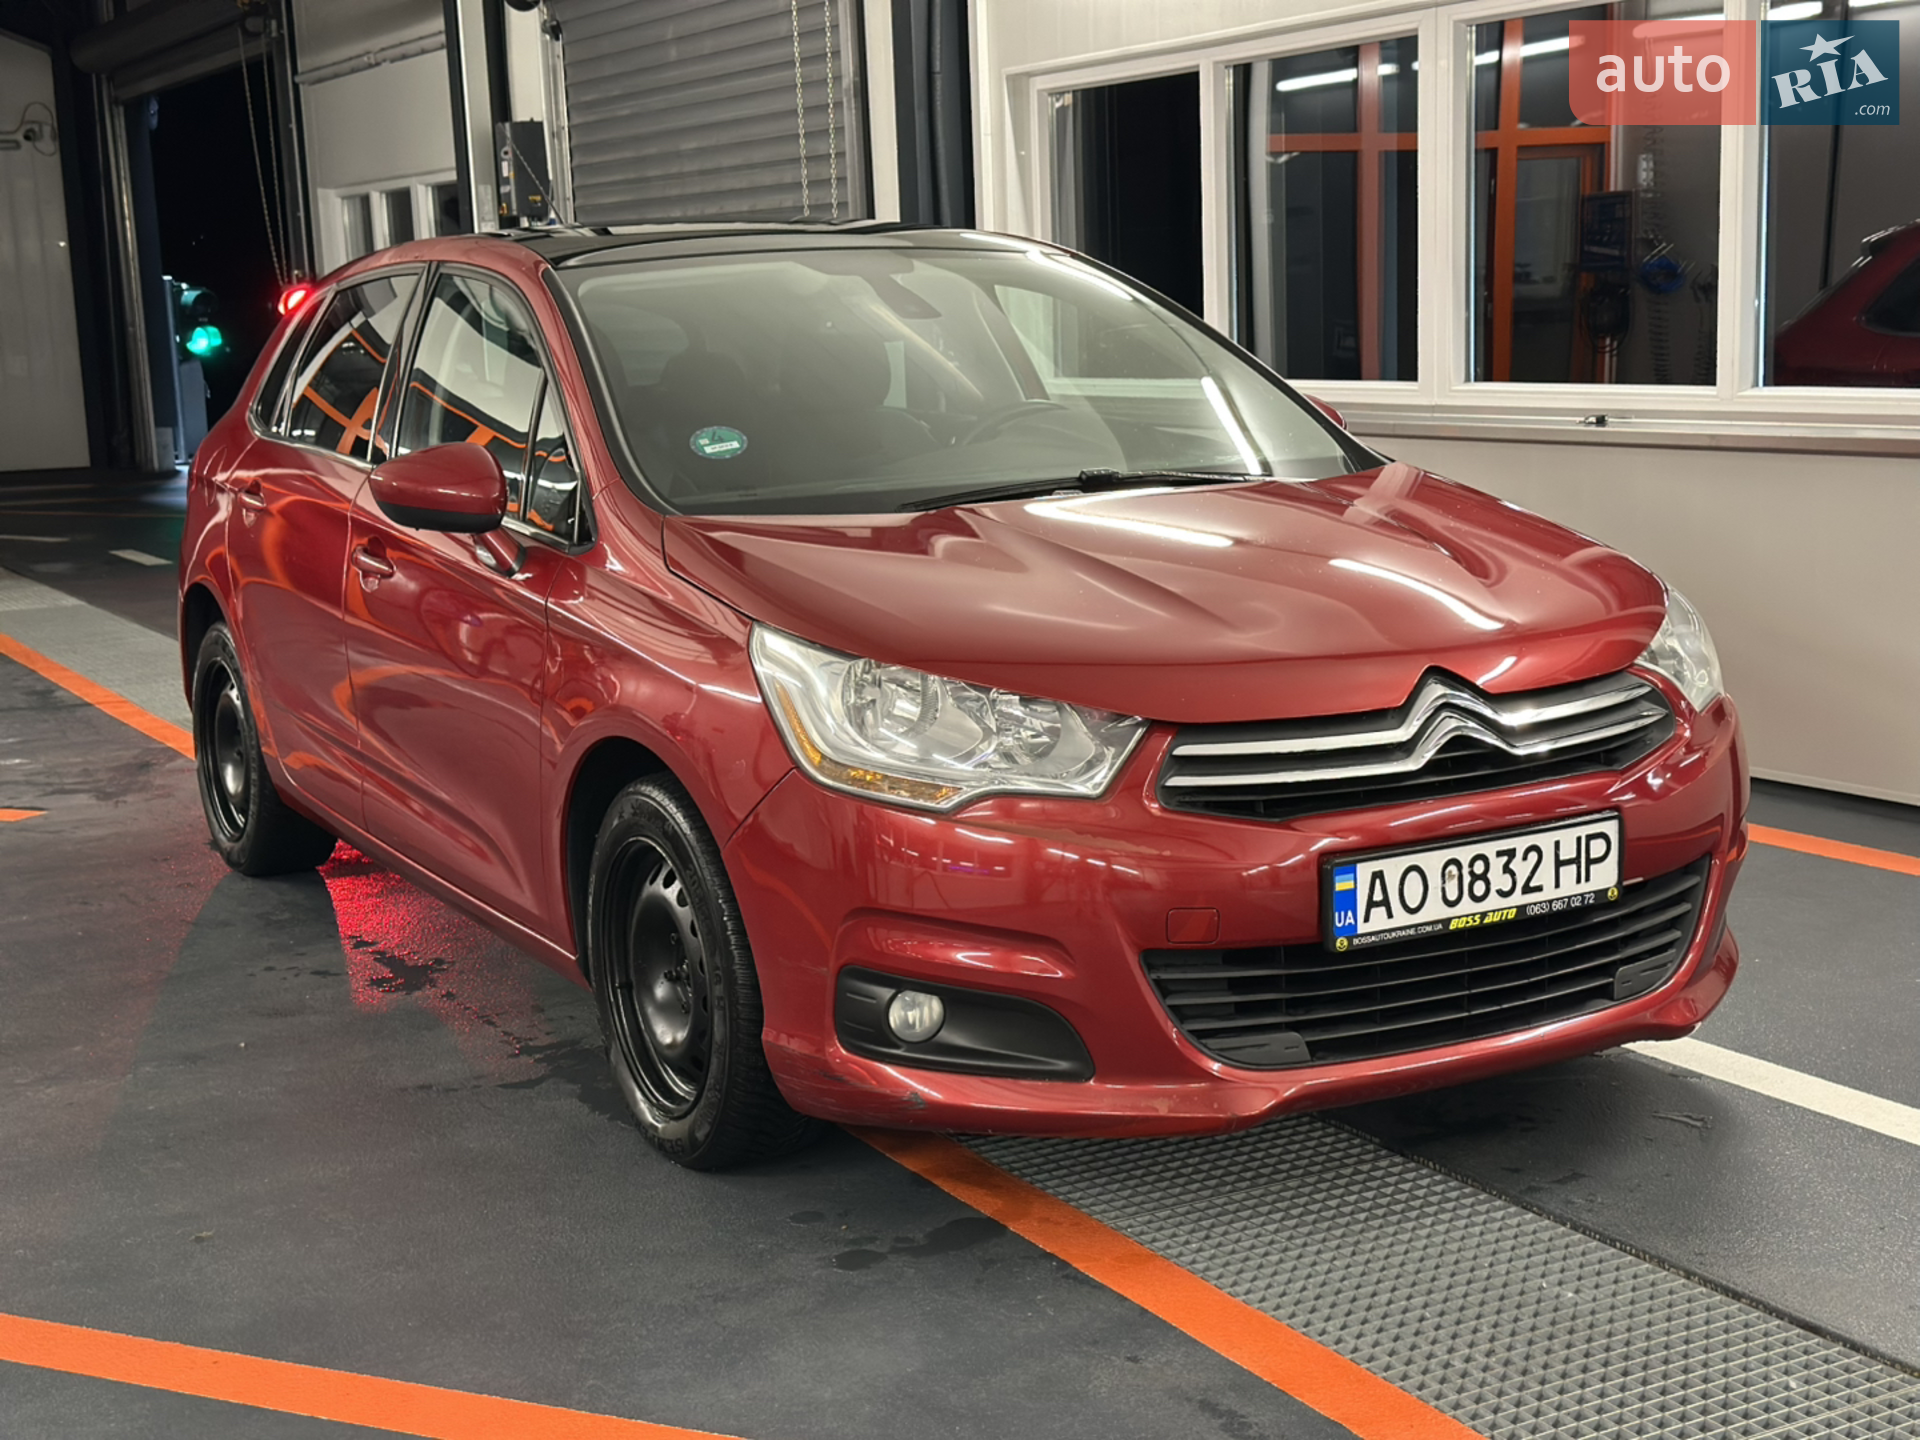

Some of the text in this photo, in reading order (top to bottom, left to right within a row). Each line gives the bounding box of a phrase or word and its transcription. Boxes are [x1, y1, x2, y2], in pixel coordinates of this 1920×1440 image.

[1363, 831, 1612, 923] AO 0832 HP
[1526, 893, 1595, 916] (063) 667 02 72
[1335, 909, 1355, 928] UA
[1449, 907, 1517, 930] BOSS AUTO
[1353, 923, 1443, 946] BOSSAUTOUKRAINE.COM.UA
